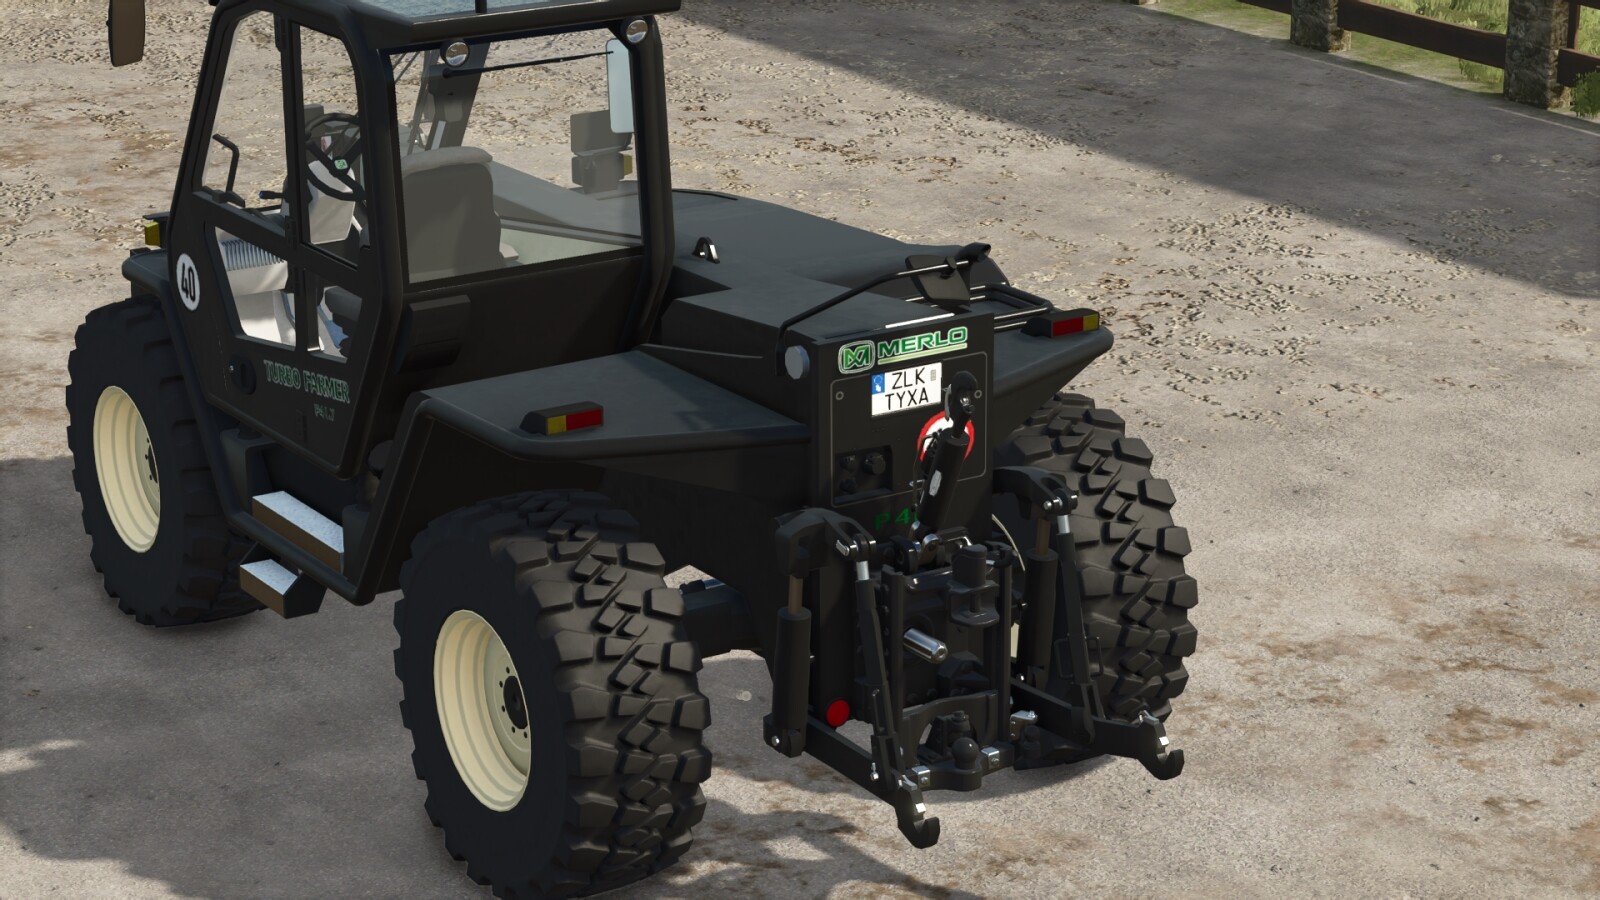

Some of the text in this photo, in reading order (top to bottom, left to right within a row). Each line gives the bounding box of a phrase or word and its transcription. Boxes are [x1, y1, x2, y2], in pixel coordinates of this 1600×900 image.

[180, 262, 195, 303] 40
[878, 326, 968, 358] MERLO
[263, 359, 350, 403] TURBO FARMER
[891, 367, 925, 390] ZLK
[885, 387, 929, 410] TYXA
